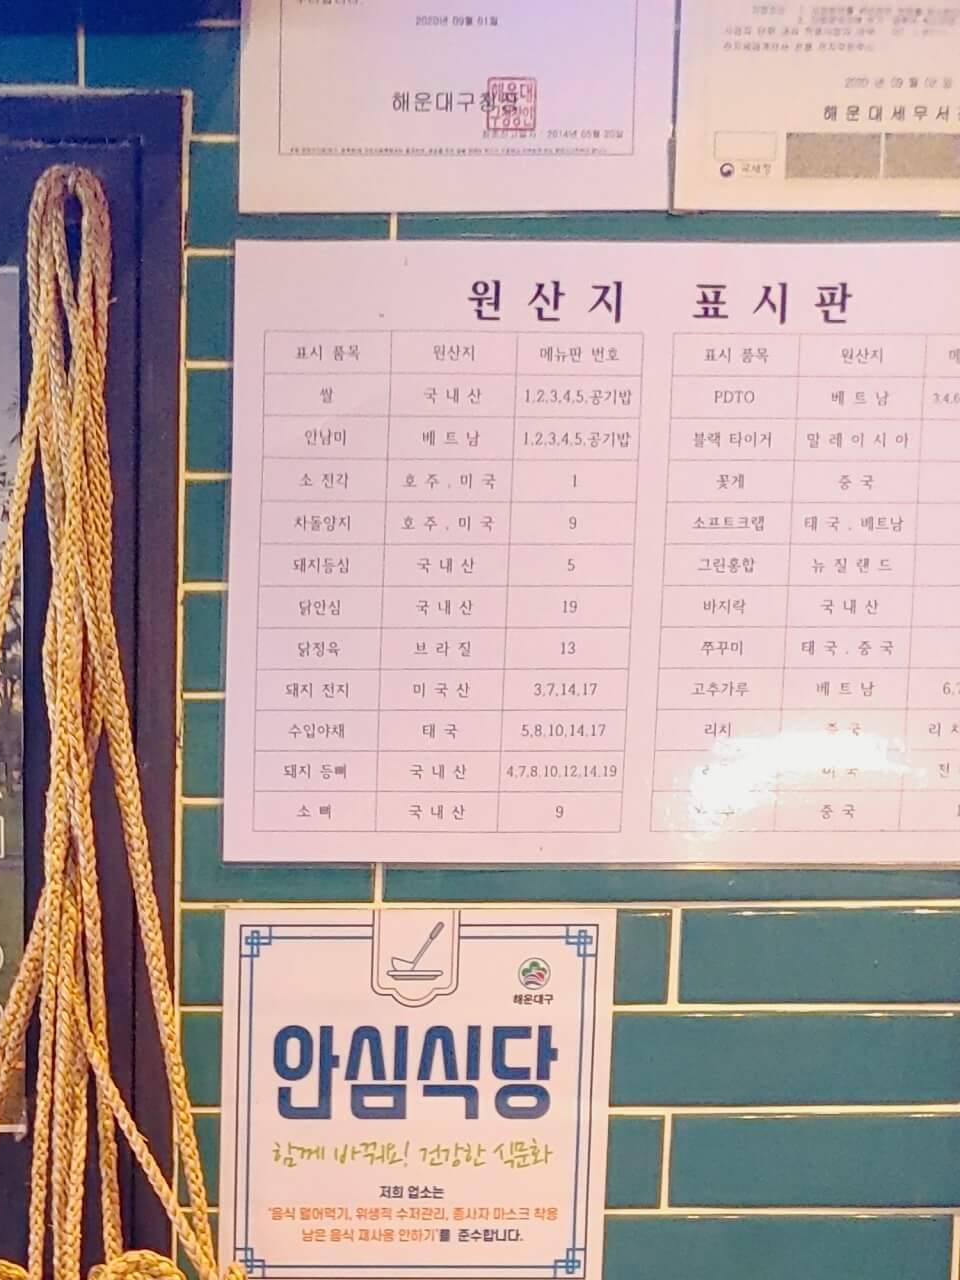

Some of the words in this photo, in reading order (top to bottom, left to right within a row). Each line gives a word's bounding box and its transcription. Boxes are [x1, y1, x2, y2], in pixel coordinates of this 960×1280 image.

[297, 345, 322, 360] 표시
[434, 344, 474, 361] 원산지
[592, 347, 619, 363] 번호
[704, 347, 731, 363] 표시
[842, 348, 883, 364] 원산지
[320, 387, 333, 403] 쌀
[715, 390, 754, 403] PDTO
[730, 432, 771, 448] 타이거
[573, 474, 576, 488] 1
[569, 516, 577, 529] 9
[568, 558, 575, 571] 5
[563, 600, 577, 613] 19
[704, 599, 745, 614] 바지락
[561, 641, 575, 655] 13
[691, 681, 748, 696] 고추가루
[288, 723, 344, 738] 수입야채
[556, 805, 564, 818] 9
[513, 994, 553, 1005] 해운대구
[273, 1025, 558, 1120] 안심식당
[272, 1142, 325, 1168] 함께
[419, 1143, 486, 1167] 건강한
[494, 1138, 553, 1168] 식문화
[380, 1186, 403, 1198] 저희
[408, 1186, 444, 1199] 업소는
[453, 1208, 490, 1221] 종사자
[493, 1208, 529, 1220] 마스크
[534, 1208, 558, 1221] 착용
[302, 1229, 326, 1242] 남은
[330, 1229, 354, 1242] 음식
[358, 1229, 394, 1242] 재사용
